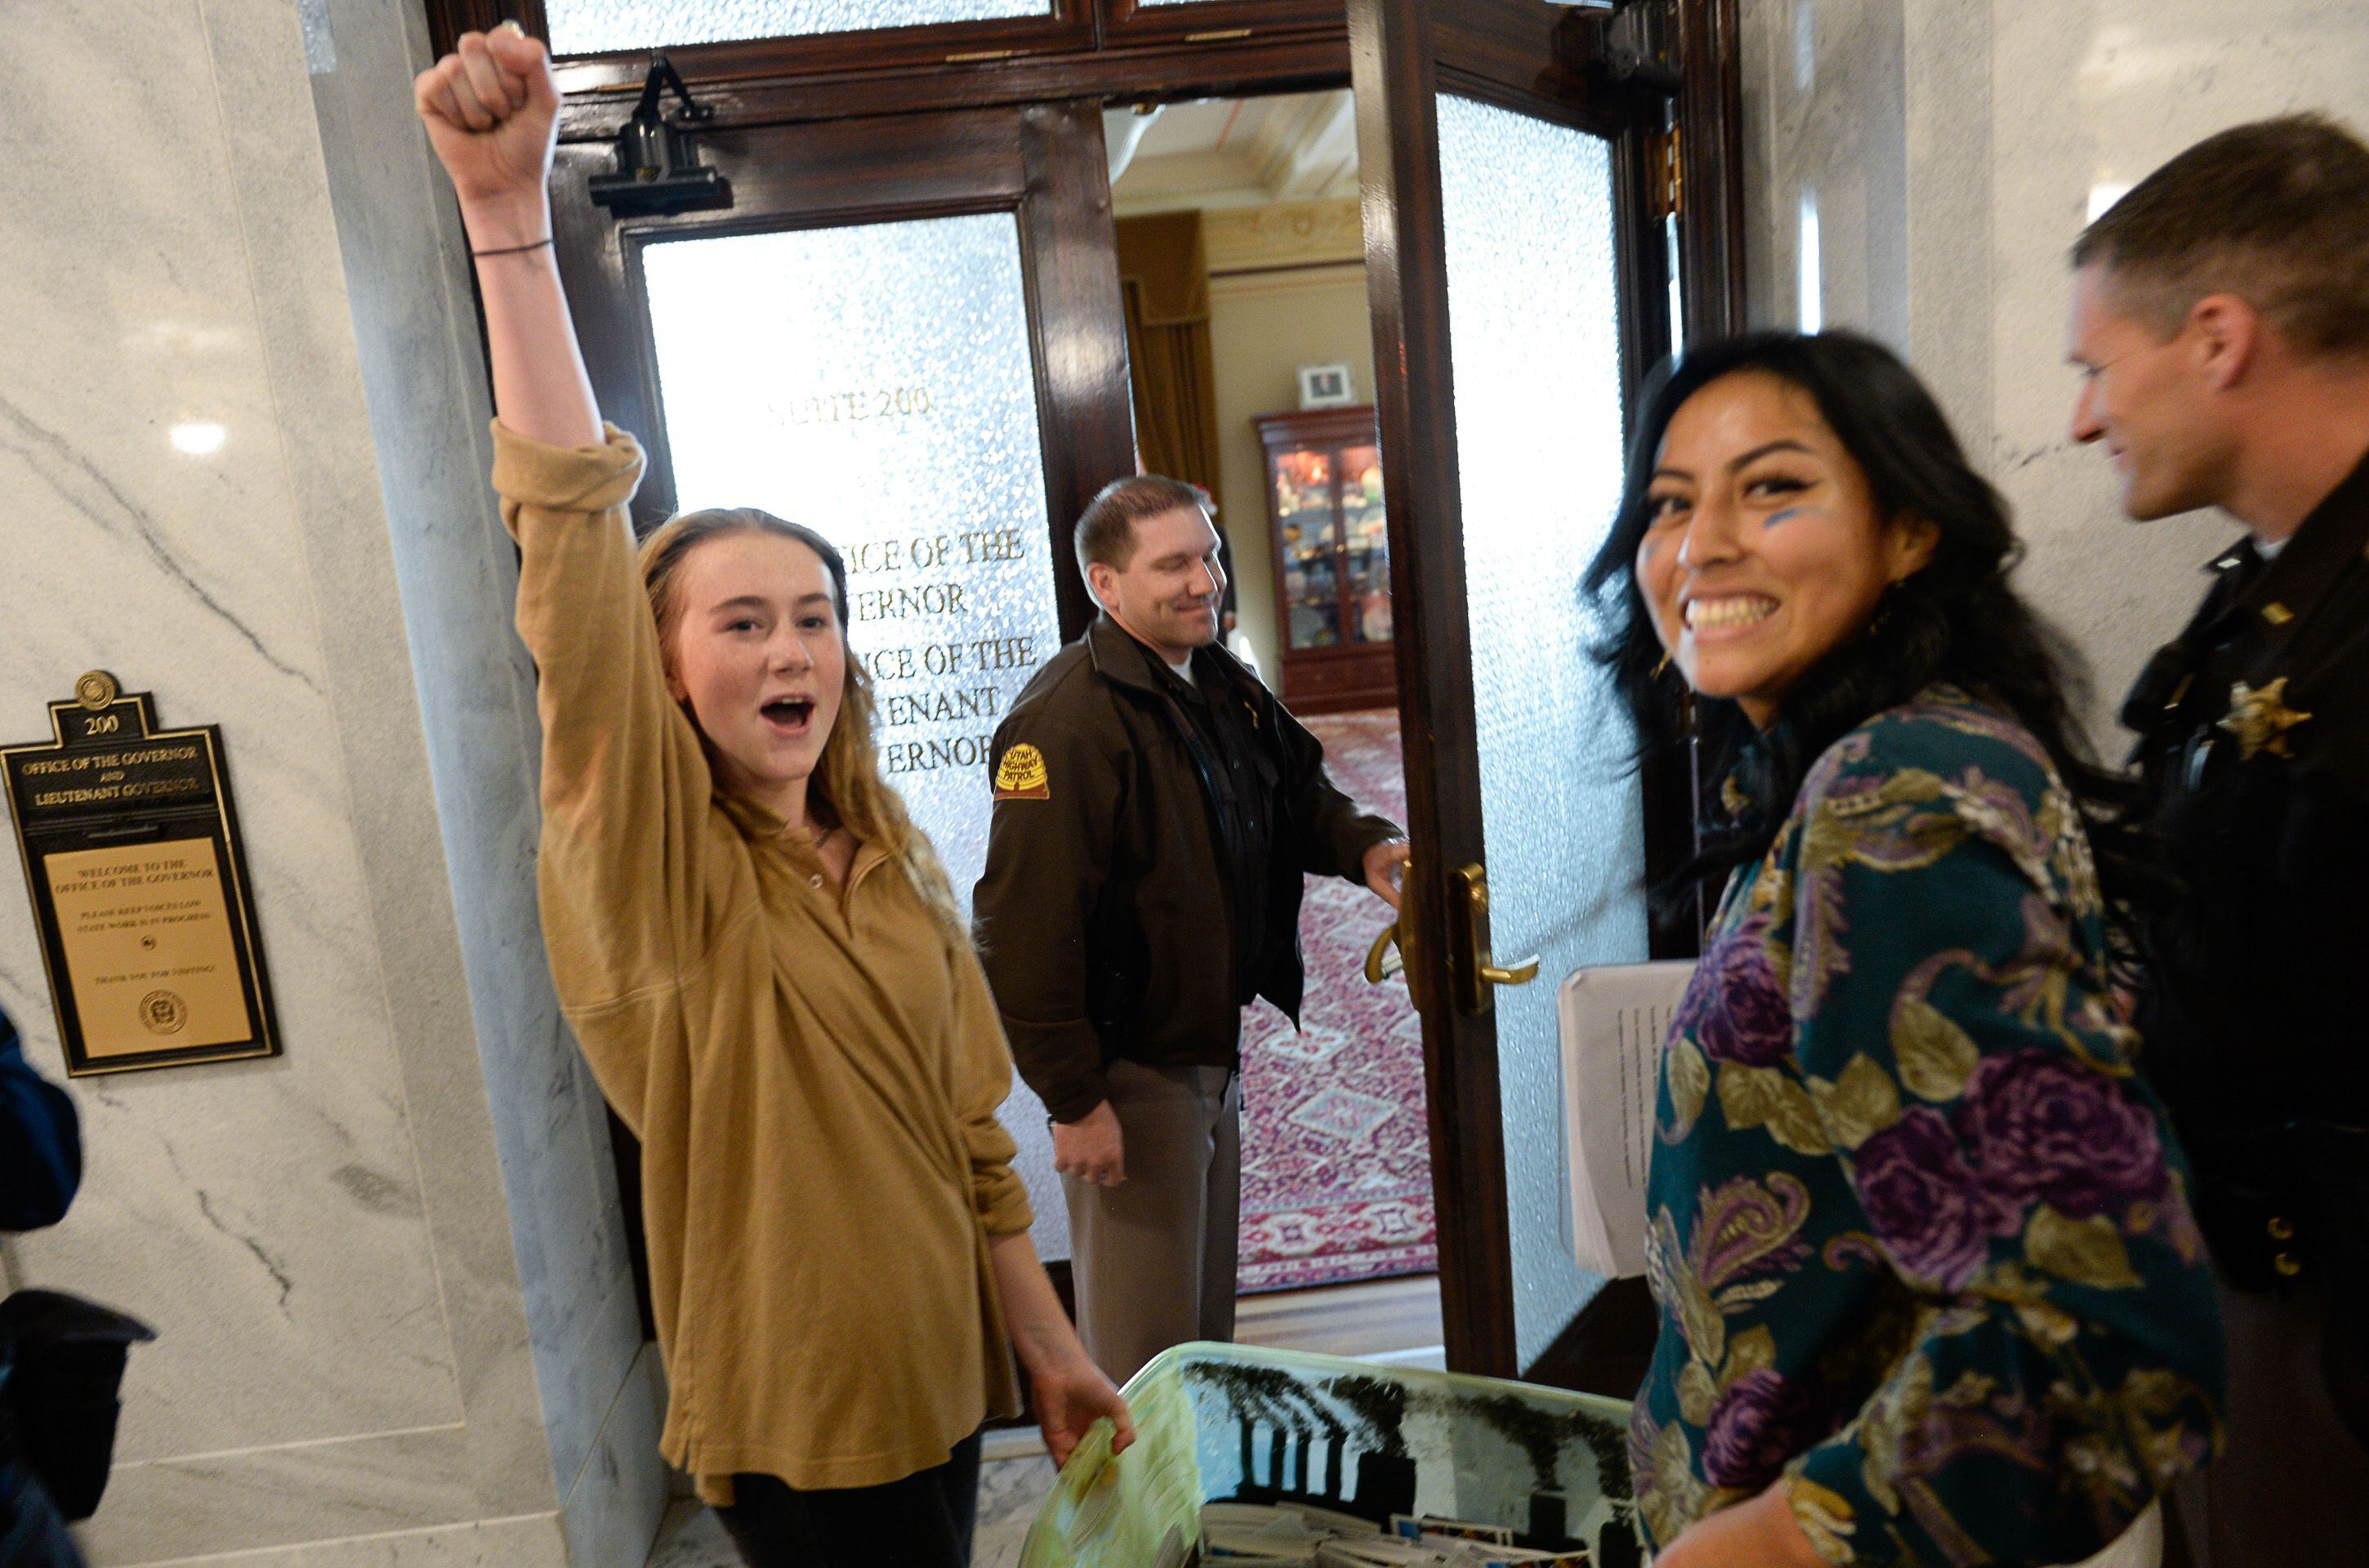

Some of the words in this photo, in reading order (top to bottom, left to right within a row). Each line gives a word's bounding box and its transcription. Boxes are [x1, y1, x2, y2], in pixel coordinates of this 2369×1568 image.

[873, 386, 930, 416] 200
[846, 539, 900, 574] ICE
[910, 535, 949, 568] OF
[959, 528, 1024, 564] THE
[858, 583, 969, 621] ERNOR
[865, 648, 916, 680] ICE
[925, 644, 962, 676] OF
[972, 637, 1037, 670] THE
[888, 687, 1001, 726] ENANT
[85, 715, 119, 735] 200
[21, 759, 71, 776] OFFICE
[72, 756, 91, 771] OF
[91, 753, 121, 768] THE
[121, 746, 199, 766] GOVERNOR
[886, 735, 992, 773] ERNOR
[1003, 755, 1037, 772] HIGHWAY
[1010, 748, 1033, 760] UTAH
[100, 770, 125, 783] AND
[1004, 769, 1035, 782] PATROL
[34, 785, 122, 806] LIEUTENANT
[122, 777, 199, 797] GOVERNOR
[55, 880, 97, 894] OFFICE
[122, 875, 144, 887] THE
[146, 868, 214, 884] GOVERNOR
[78, 863, 139, 878] WELCOME
[144, 862, 160, 872] TO
[163, 858, 185, 870] THE
